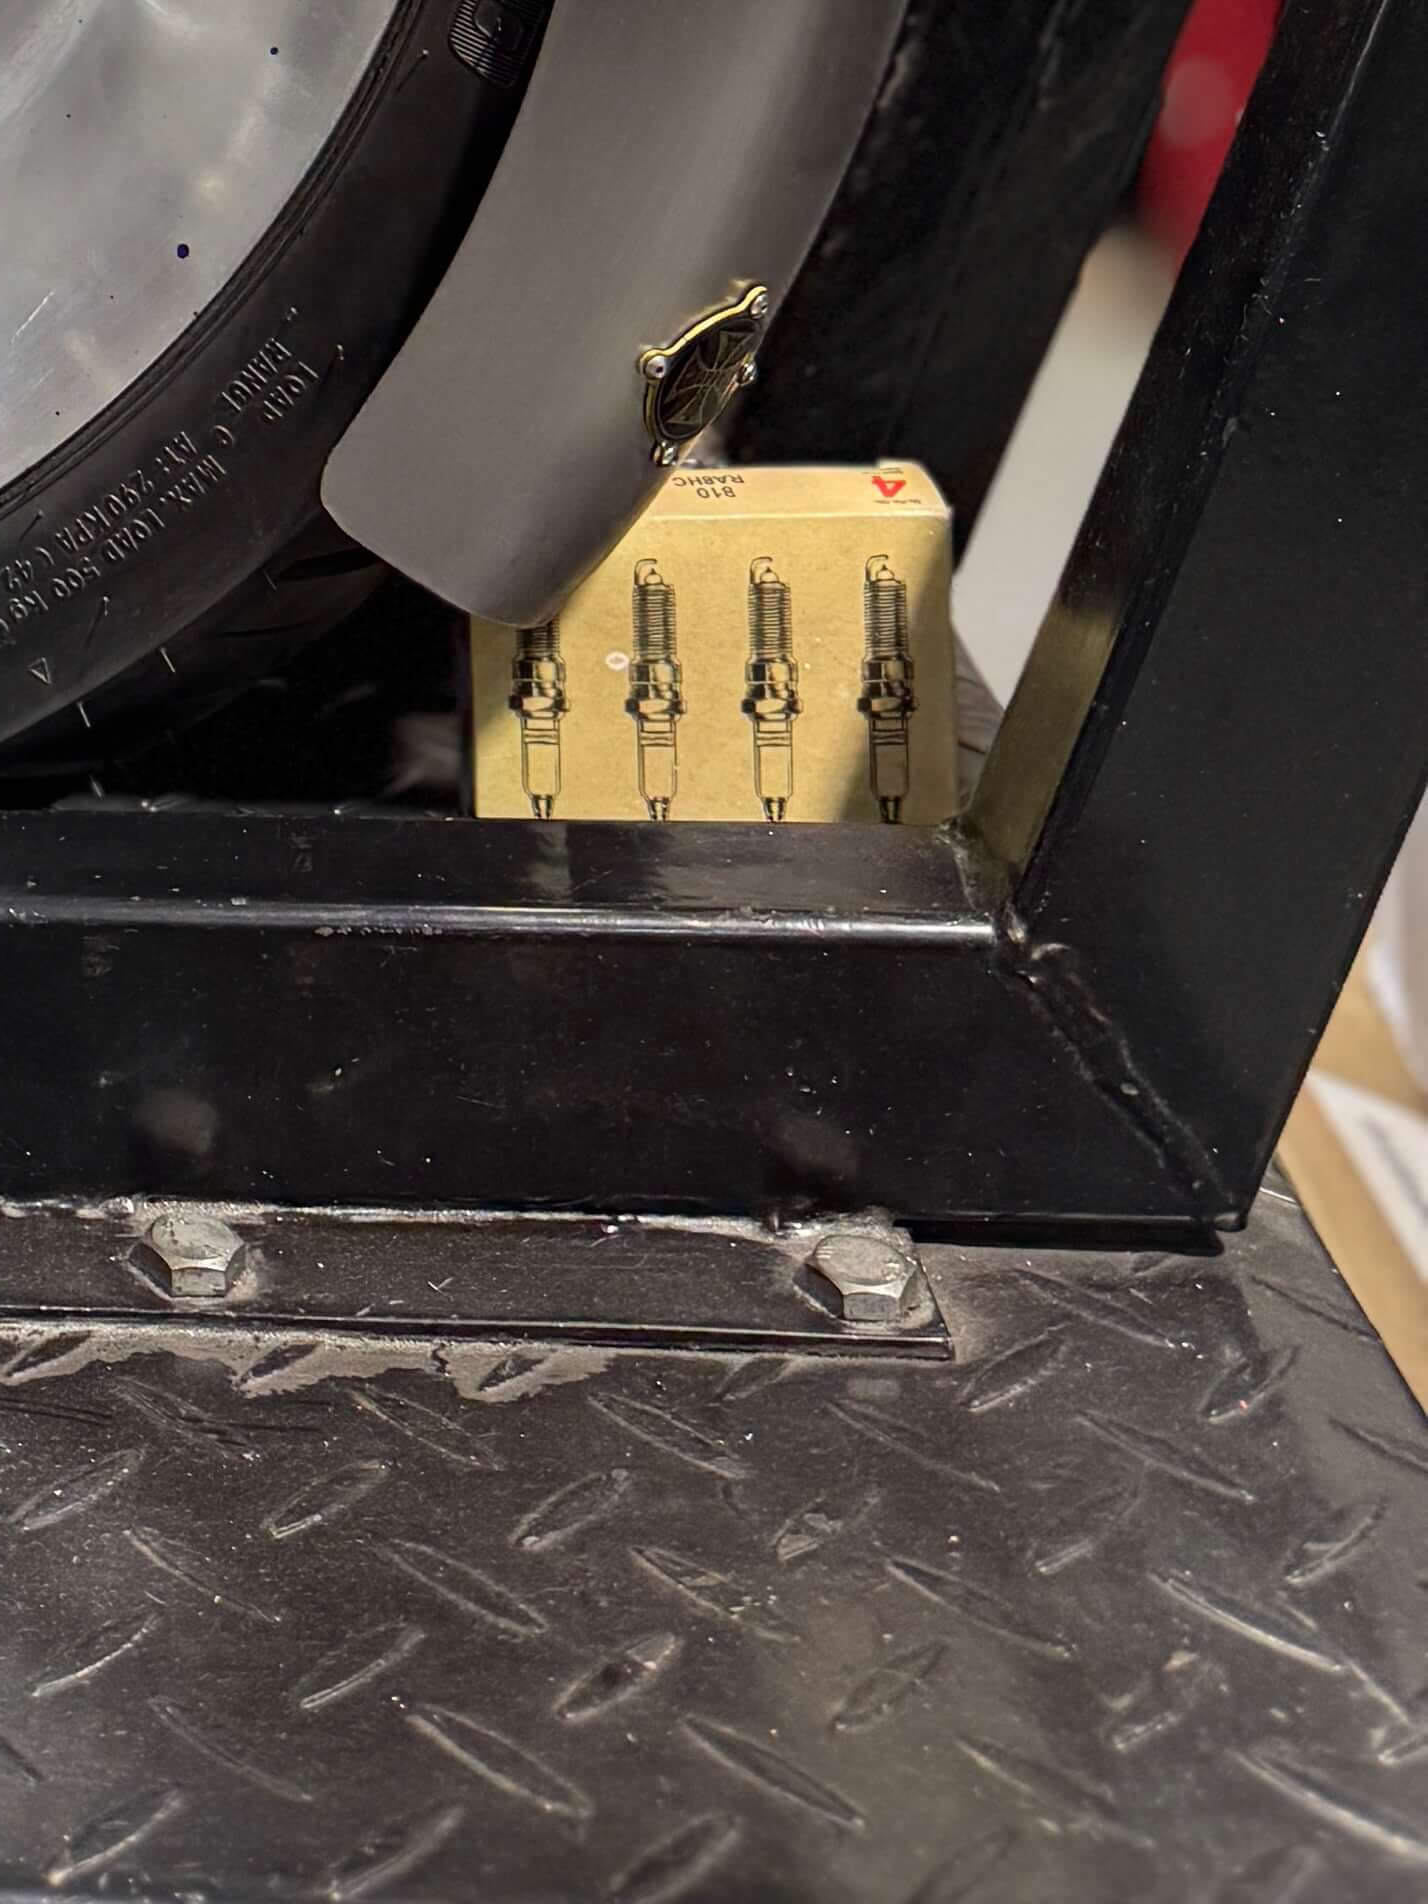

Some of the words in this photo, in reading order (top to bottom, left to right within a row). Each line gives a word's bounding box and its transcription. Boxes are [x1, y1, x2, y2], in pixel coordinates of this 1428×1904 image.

[250, 355, 323, 429] LOAD
[696, 487, 737, 499] 810
[871, 475, 907, 498] 4
[94, 502, 168, 569] LOAD
[44, 551, 104, 604] 500
